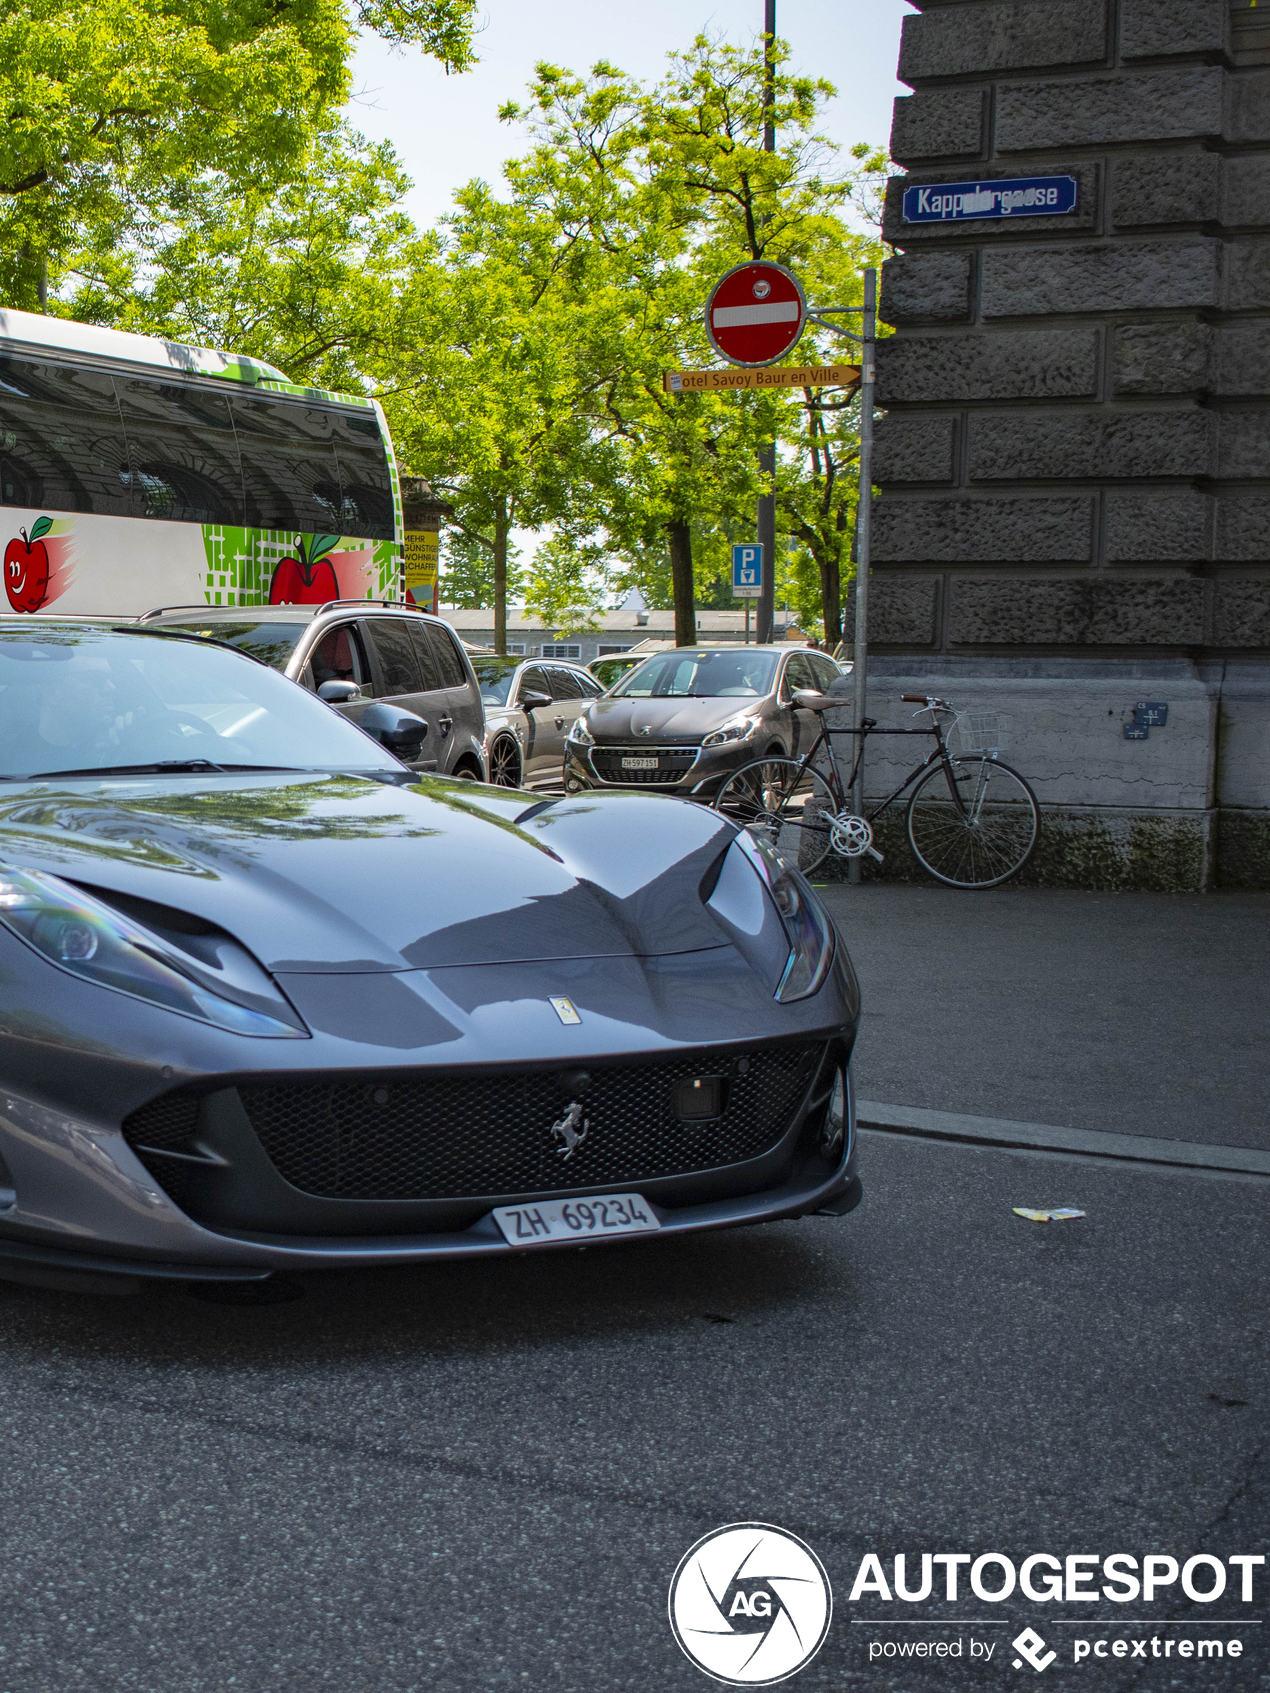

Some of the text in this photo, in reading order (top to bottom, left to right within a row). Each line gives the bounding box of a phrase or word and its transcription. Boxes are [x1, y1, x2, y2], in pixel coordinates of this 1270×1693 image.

[682, 369, 840, 388] otel Savoy Baur en Ville
[404, 534, 425, 543] MEHR
[742, 549, 755, 568] P
[505, 1199, 648, 1238] ZH 69234
